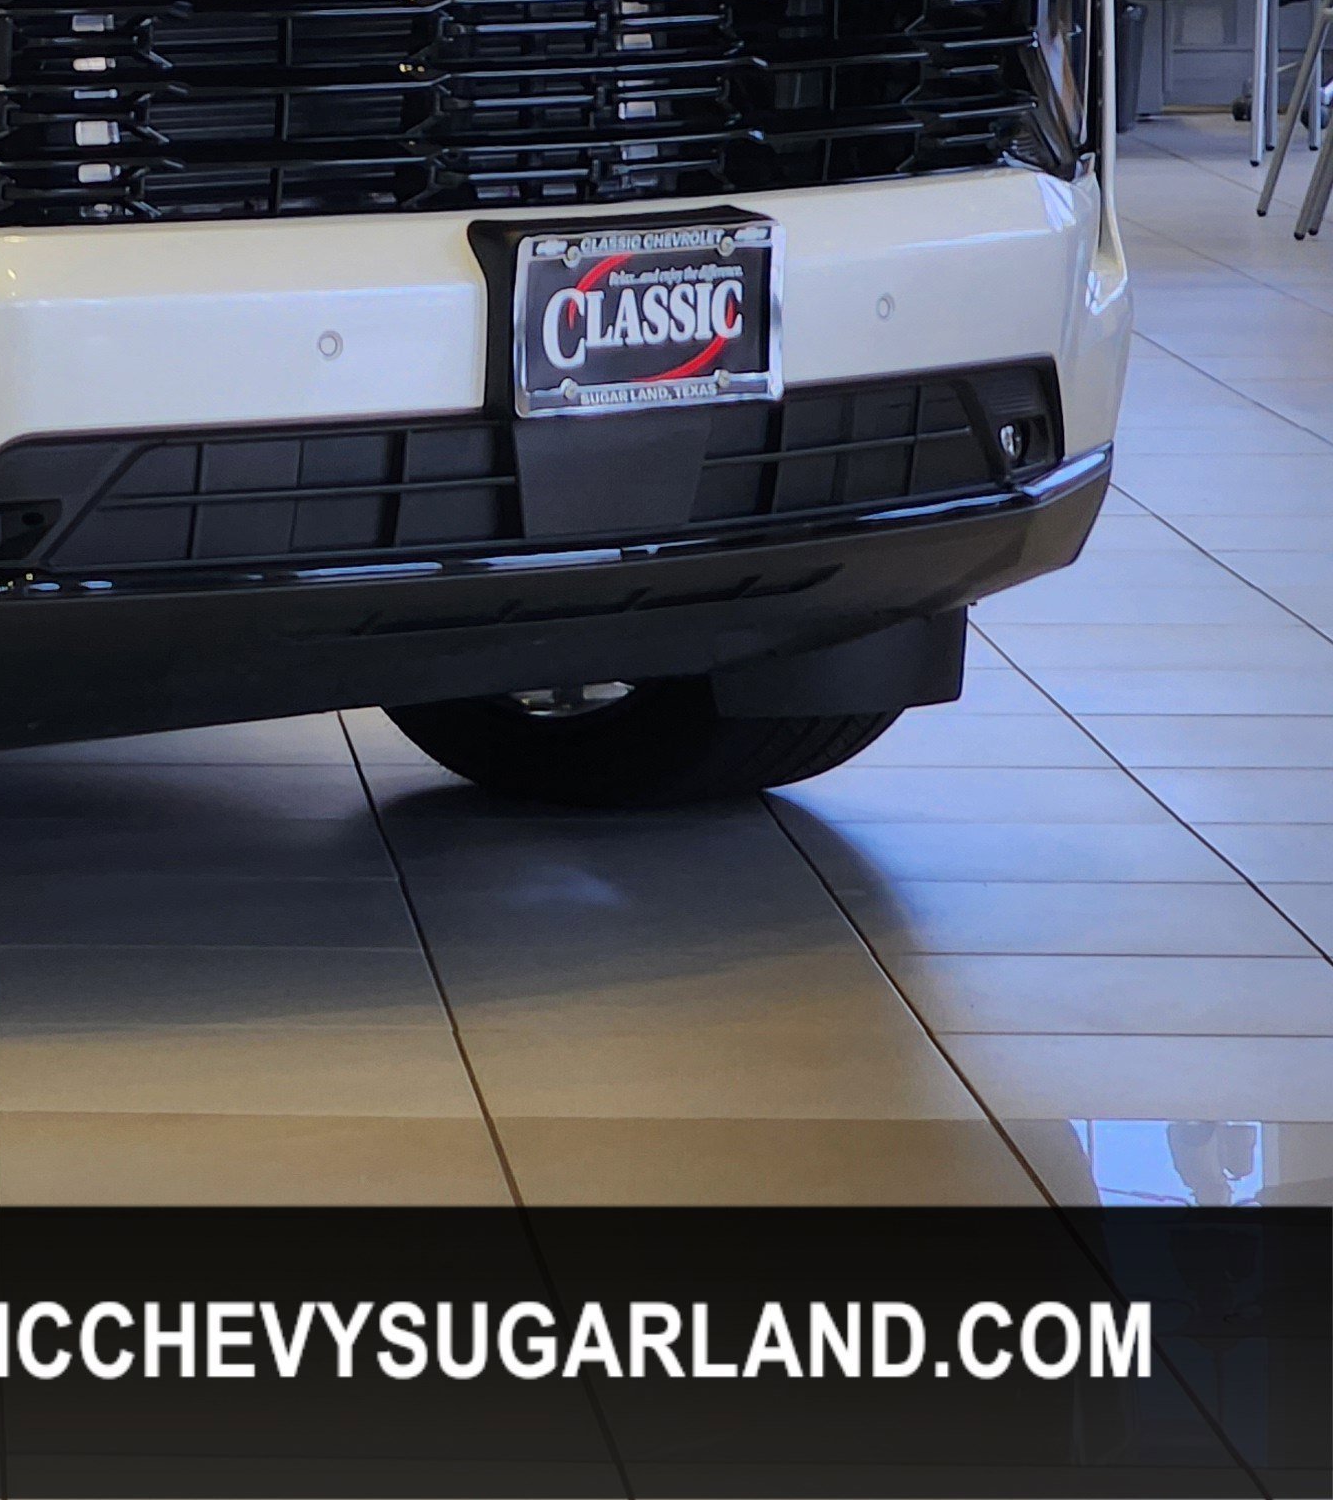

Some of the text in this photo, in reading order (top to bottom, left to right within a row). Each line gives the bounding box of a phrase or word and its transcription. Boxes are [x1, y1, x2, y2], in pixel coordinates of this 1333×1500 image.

[581, 228, 725, 252] CLASSIC CHEVROLET
[542, 279, 744, 369] CLASSIC
